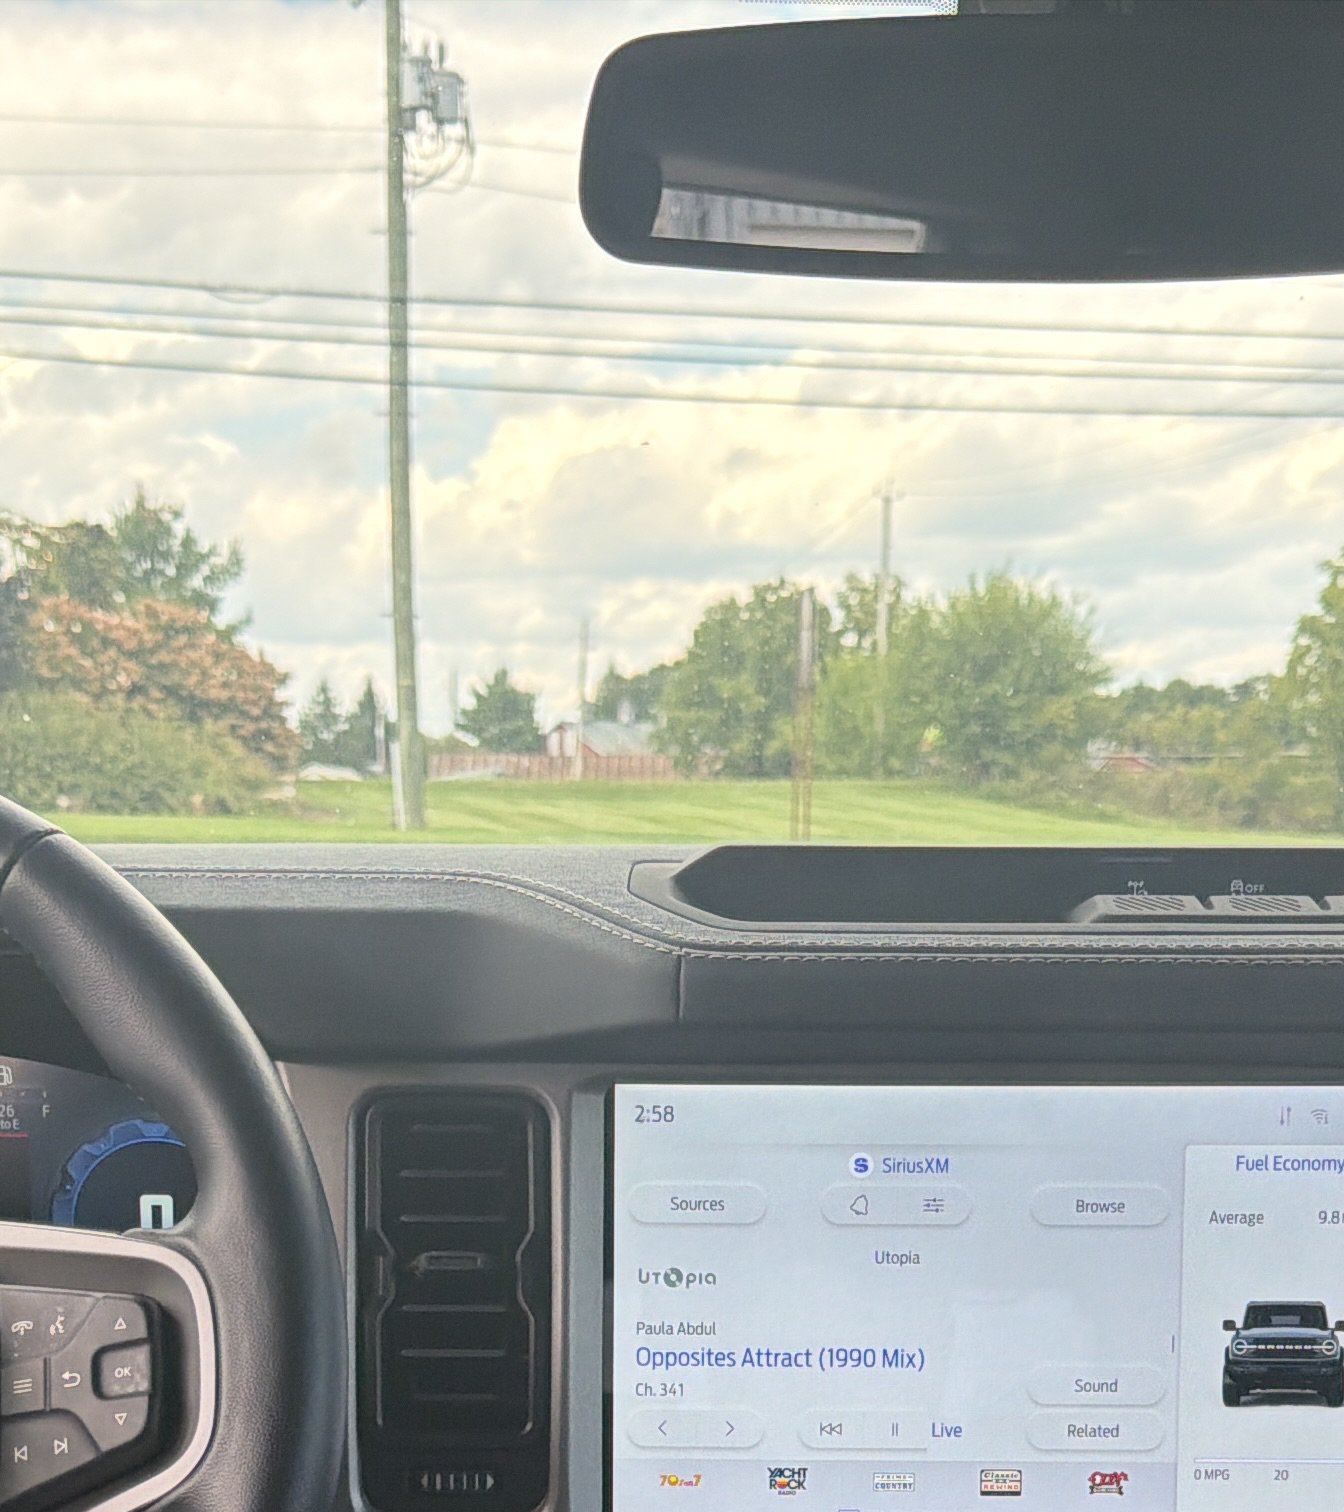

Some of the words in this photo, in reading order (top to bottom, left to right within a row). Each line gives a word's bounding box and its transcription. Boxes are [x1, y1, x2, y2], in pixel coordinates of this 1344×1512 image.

[1244, 884, 1265, 894] OFF
[42, 1104, 51, 1118] F
[635, 1105, 675, 1124] 2:58
[0, 1119, 11, 1129] to
[882, 1157, 950, 1175] SiriusXM
[1236, 1155, 1269, 1172] Fuel
[670, 1196, 725, 1212] Sources
[1075, 1198, 1126, 1214] Browse
[1209, 1210, 1264, 1227] Average
[1318, 1210, 1340, 1225] 9.8
[874, 1250, 921, 1268] Utopia
[636, 1322, 674, 1336] Paula
[677, 1321, 716, 1336] Abdul
[636, 1346, 736, 1370] Opposites
[741, 1347, 812, 1368] Attract
[819, 1346, 876, 1372] (1990
[882, 1346, 925, 1372] Mix)
[114, 1366, 132, 1378] OK
[635, 1382, 657, 1397] Ch.
[659, 1382, 684, 1397] 341
[1074, 1378, 1118, 1394] Sound
[931, 1422, 963, 1438] Live
[1067, 1422, 1120, 1439] Related
[767, 1467, 808, 1479] YACHT
[1194, 1469, 1201, 1481] 0
[1204, 1469, 1230, 1481] MPG
[1273, 1469, 1289, 1481] 20
[768, 1478, 806, 1490] ROCK
